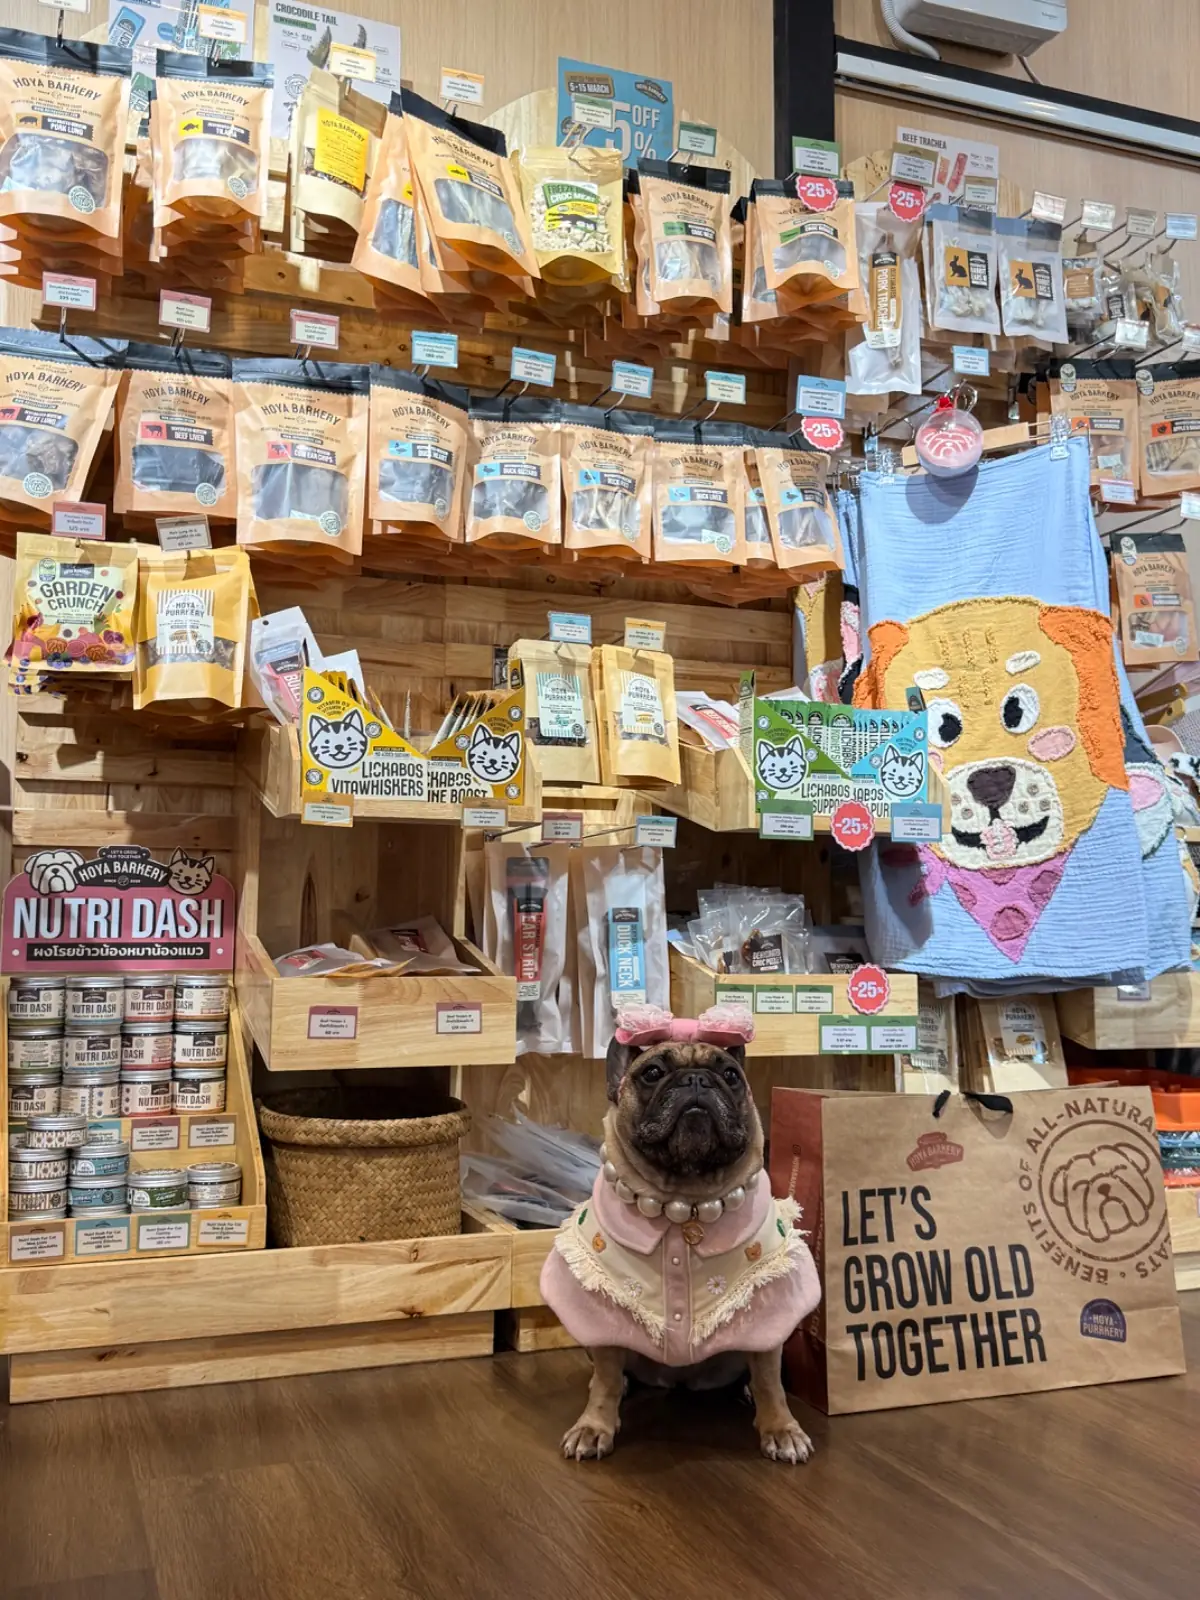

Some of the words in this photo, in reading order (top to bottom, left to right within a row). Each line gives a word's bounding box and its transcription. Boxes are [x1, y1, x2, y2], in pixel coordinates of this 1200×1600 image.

[275, 2, 320, 21] CROCODILE
[321, 13, 339, 26] TAIL
[13, 77, 44, 88] HOYA
[47, 79, 102, 100] BARKERY
[587, 83, 609, 94] MARCH
[632, 104, 661, 129] OFF
[902, 132, 917, 144] BEEF
[918, 136, 947, 149] TRACHEA
[5, 371, 35, 383] HOYA
[38, 372, 87, 392] BARKERY
[142, 387, 166, 399] HOYA
[168, 386, 210, 406] BARKERY
[1070, 390, 1087, 401] HOYA
[1088, 390, 1120, 401] BARKERY
[1149, 393, 1168, 406] HOYA
[261, 402, 290, 416] HOYA
[292, 403, 342, 426] BARKERY
[392, 405, 415, 418] HOYA
[415, 406, 451, 430] BARKERY
[174, 432, 189, 441] BEEF
[189, 432, 205, 442] LIVER
[479, 434, 500, 448] HOYA
[500, 432, 539, 446] BARKERY
[806, 424, 837, 438] -25%
[598, 441, 633, 459] BARKERY
[39, 580, 115, 603] GARDEN
[47, 596, 105, 614] CRUNCH
[175, 602, 195, 610] HOYA
[331, 778, 424, 797] VITAWHISKERS
[427, 789, 447, 803] INE
[450, 788, 488, 804] BOOST
[812, 798, 843, 814] SUPPO
[835, 818, 869, 835] -25%
[79, 862, 111, 882] HOYA
[113, 861, 168, 883] BARKERY
[13, 897, 121, 939] NUTRI
[131, 898, 224, 939] DASH
[521, 914, 532, 940] EAR
[616, 924, 629, 955] DUCK
[33, 943, 204, 957] ผงโรยข้าวน้องหมาน้องแมว
[522, 944, 534, 979] STRIP
[618, 957, 633, 987] NECK
[851, 981, 884, 999] -25%
[30, 1002, 52, 1013] DASH
[72, 1004, 95, 1014] NUTRI
[96, 1004, 117, 1014] DASH
[130, 1001, 153, 1012] NUTRI
[155, 1001, 173, 1011] DASH
[176, 1000, 193, 1010] DASH
[75, 1051, 100, 1062] NUTRI
[101, 1051, 118, 1061] DASH
[124, 1049, 144, 1059] DASH
[181, 1047, 204, 1057] NUTRI
[206, 1047, 224, 1057] DASH
[8, 1101, 23, 1111] TRI
[25, 1101, 46, 1111] DASH
[138, 1097, 160, 1107] NUTRI
[190, 1094, 211, 1105] DASH
[1026, 1097, 1158, 1154] ALL-NATURA
[908, 1149, 927, 1168] HOYA
[927, 1143, 961, 1157] BARKERY
[1018, 1158, 1033, 1191] OF
[841, 1185, 937, 1247] LET'S
[1023, 1201, 1109, 1285] BENEFITS
[843, 1247, 952, 1314] GROW
[964, 1242, 1035, 1303] OLD
[1091, 1313, 1114, 1325] HOYA
[1082, 1323, 1124, 1341] PURRKERY
[846, 1307, 1048, 1382] TOGETHER
